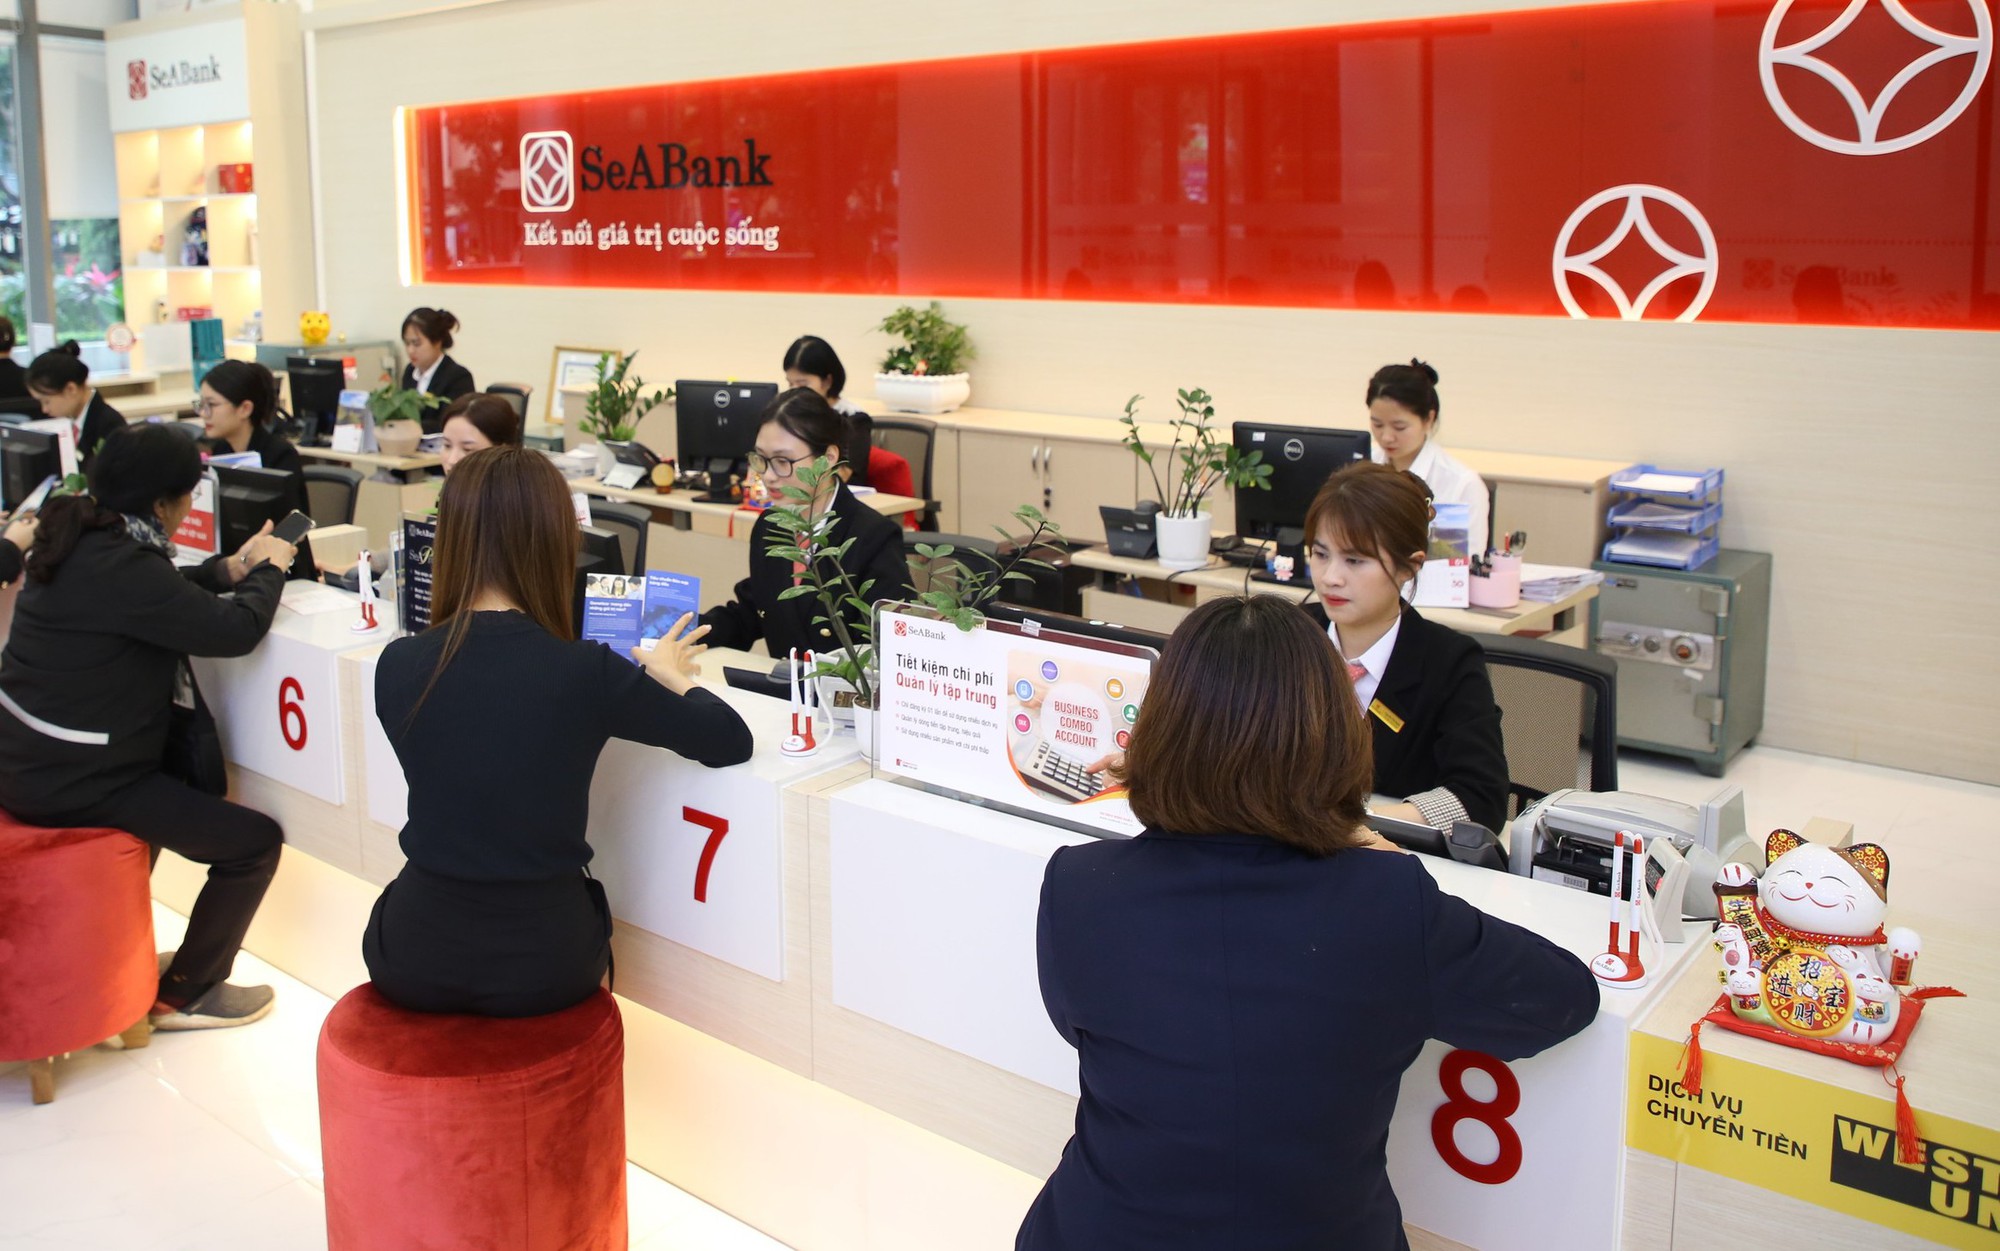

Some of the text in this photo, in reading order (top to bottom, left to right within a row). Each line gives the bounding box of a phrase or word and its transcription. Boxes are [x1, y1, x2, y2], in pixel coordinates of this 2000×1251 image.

[150, 56, 221, 90] SeABank
[581, 138, 773, 192] SeABank
[523, 216, 780, 252] Kết nối giá trị cuộc sống
[908, 625, 947, 641] SeABank
[896, 653, 994, 686] Tiết kiệm chi phí
[896, 672, 997, 709] Quản lý tập trung
[278, 676, 307, 751] 6
[1054, 700, 1099, 720] BUSINESS
[1060, 716, 1093, 733] COMBO
[1055, 729, 1097, 748] ACCOUNT
[682, 805, 729, 903] 7
[1594, 960, 1615, 973] SeABank
[1770, 957, 1846, 1027] 招 财 进 宝
[1431, 1049, 1523, 1185] 8
[1710, 1091, 1743, 1118] VỤ
[1646, 1099, 1808, 1160] CHUYỂN TIỀN
